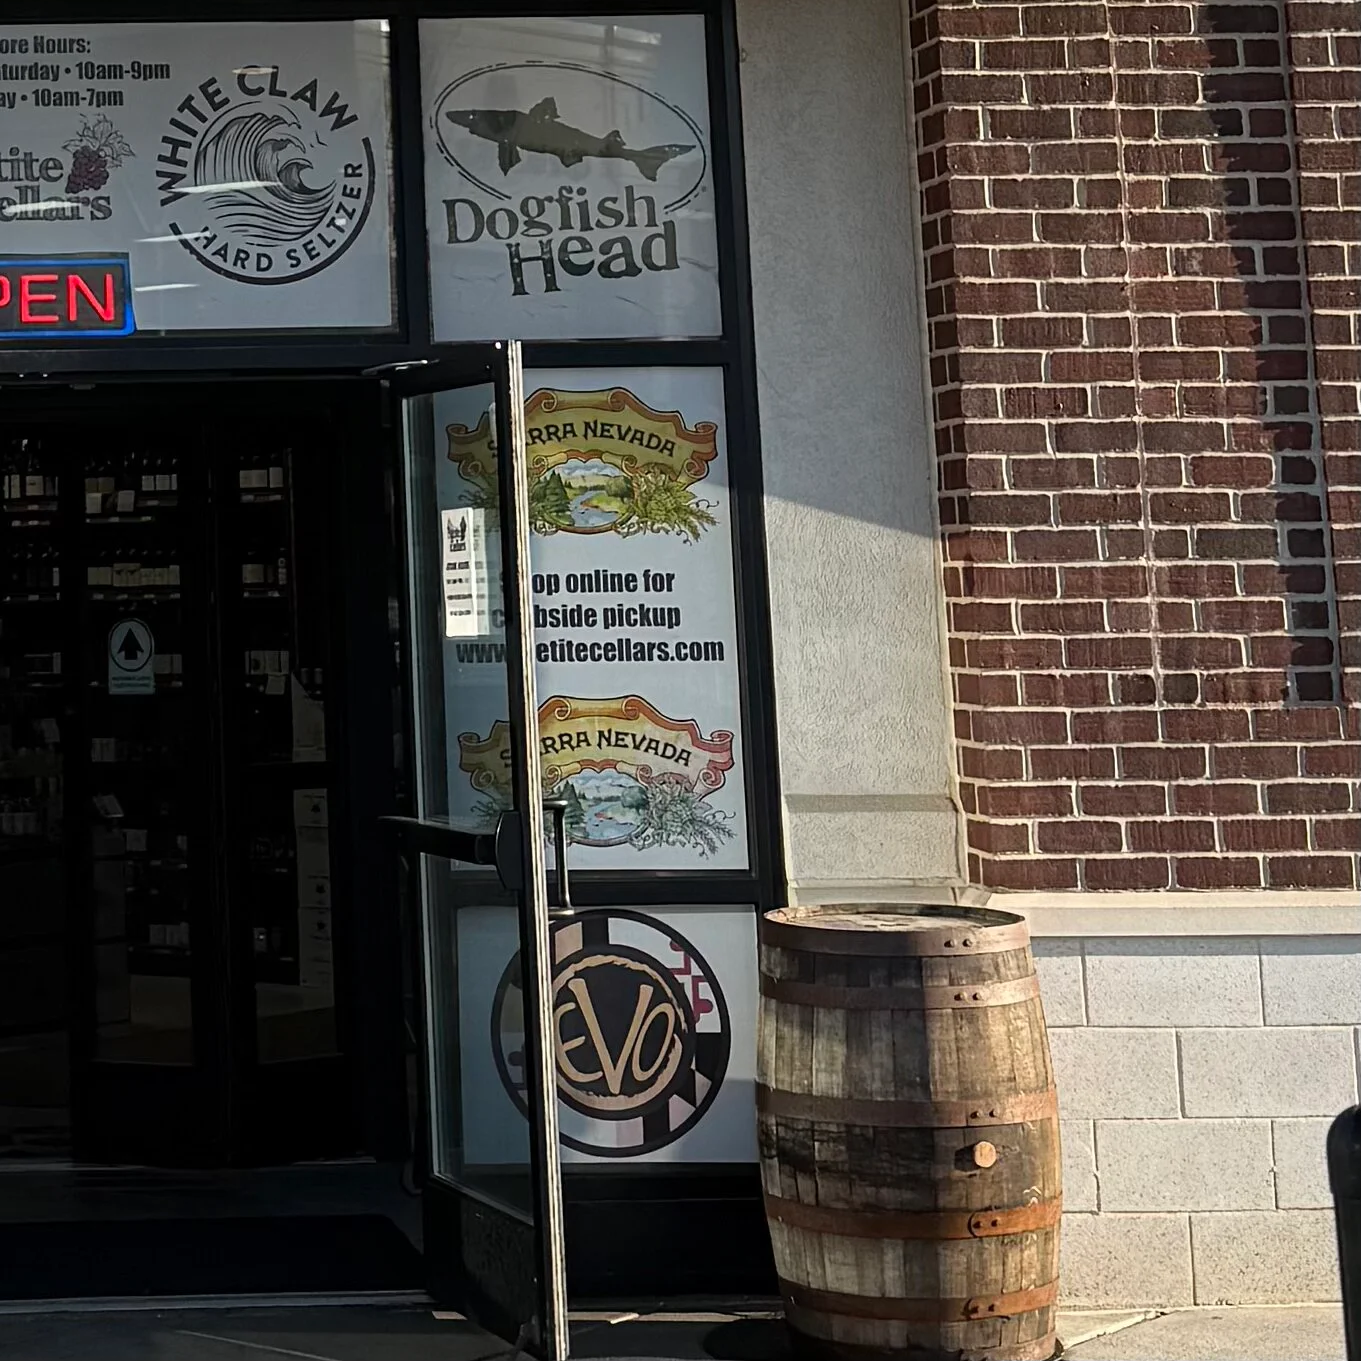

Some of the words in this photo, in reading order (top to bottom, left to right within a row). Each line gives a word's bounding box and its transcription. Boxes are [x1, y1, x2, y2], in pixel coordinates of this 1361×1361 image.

[33, 34, 92, 54] Hours:
[75, 60, 171, 81] 10am-9pm
[32, 88, 125, 108] 10am-7pm
[155, 76, 231, 208] WHITE
[236, 64, 359, 132] CLAW
[193, 225, 274, 273] HARD
[285, 161, 364, 269] SELTZER
[441, 184, 660, 245] Dogfish
[505, 219, 681, 297] Head
[487, 420, 578, 460] SRRA
[582, 418, 677, 458] NEVADA
[565, 569, 638, 594] online
[642, 568, 676, 593] for
[491, 603, 598, 630] cbside
[602, 603, 682, 630] pickup
[455, 637, 725, 664] wwwetitecellars.com
[499, 729, 593, 769] SRRA
[595, 727, 693, 768] NEVADA
[552, 977, 676, 1095] EVO
